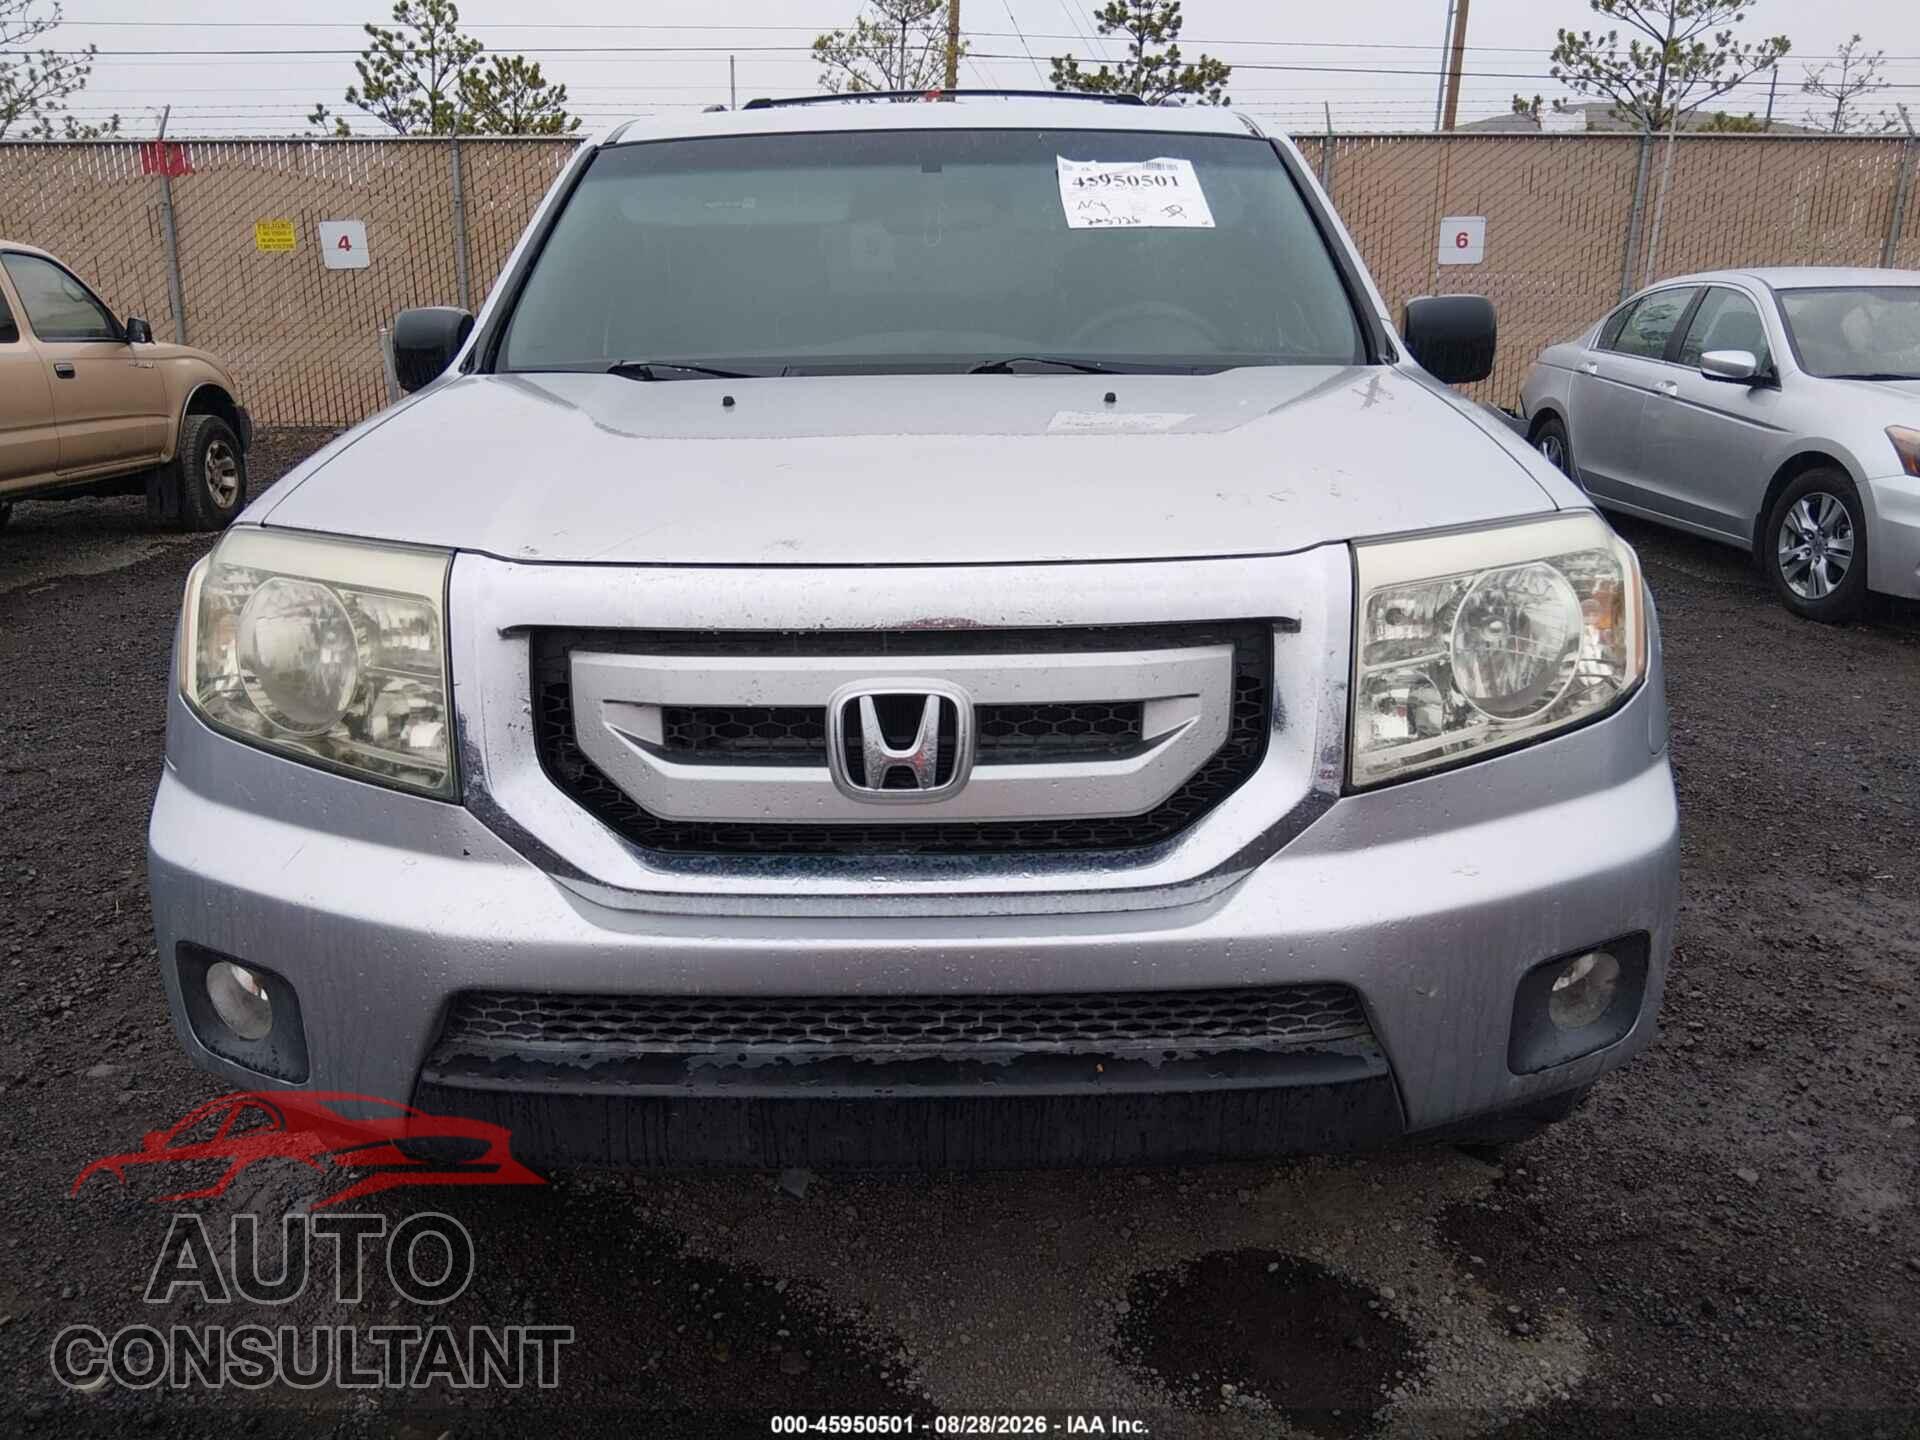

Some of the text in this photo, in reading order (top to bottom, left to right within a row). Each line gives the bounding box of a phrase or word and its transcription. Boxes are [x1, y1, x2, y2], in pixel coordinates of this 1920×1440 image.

[1072, 173, 1179, 188] 45950501
[338, 235, 352, 251] 4
[1455, 232, 1469, 249] 6
